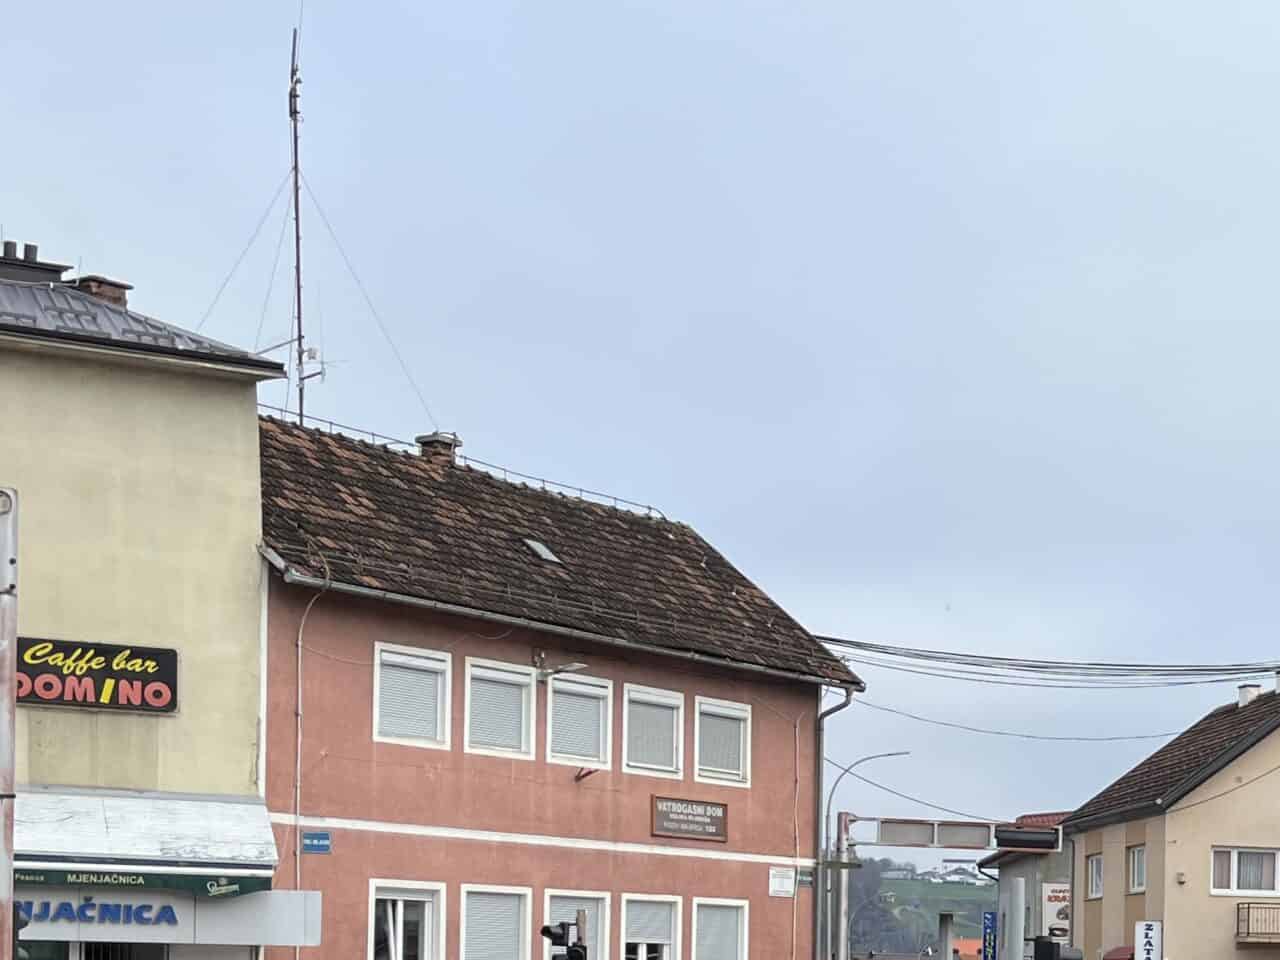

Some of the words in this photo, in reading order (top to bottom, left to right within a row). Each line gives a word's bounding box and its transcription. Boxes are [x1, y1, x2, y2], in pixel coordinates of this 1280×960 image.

[23, 642, 105, 676] Caffe
[111, 650, 159, 673] bar
[67, 873, 145, 884] MJENJAČNICA
[15, 896, 178, 925] NJAČNICA
